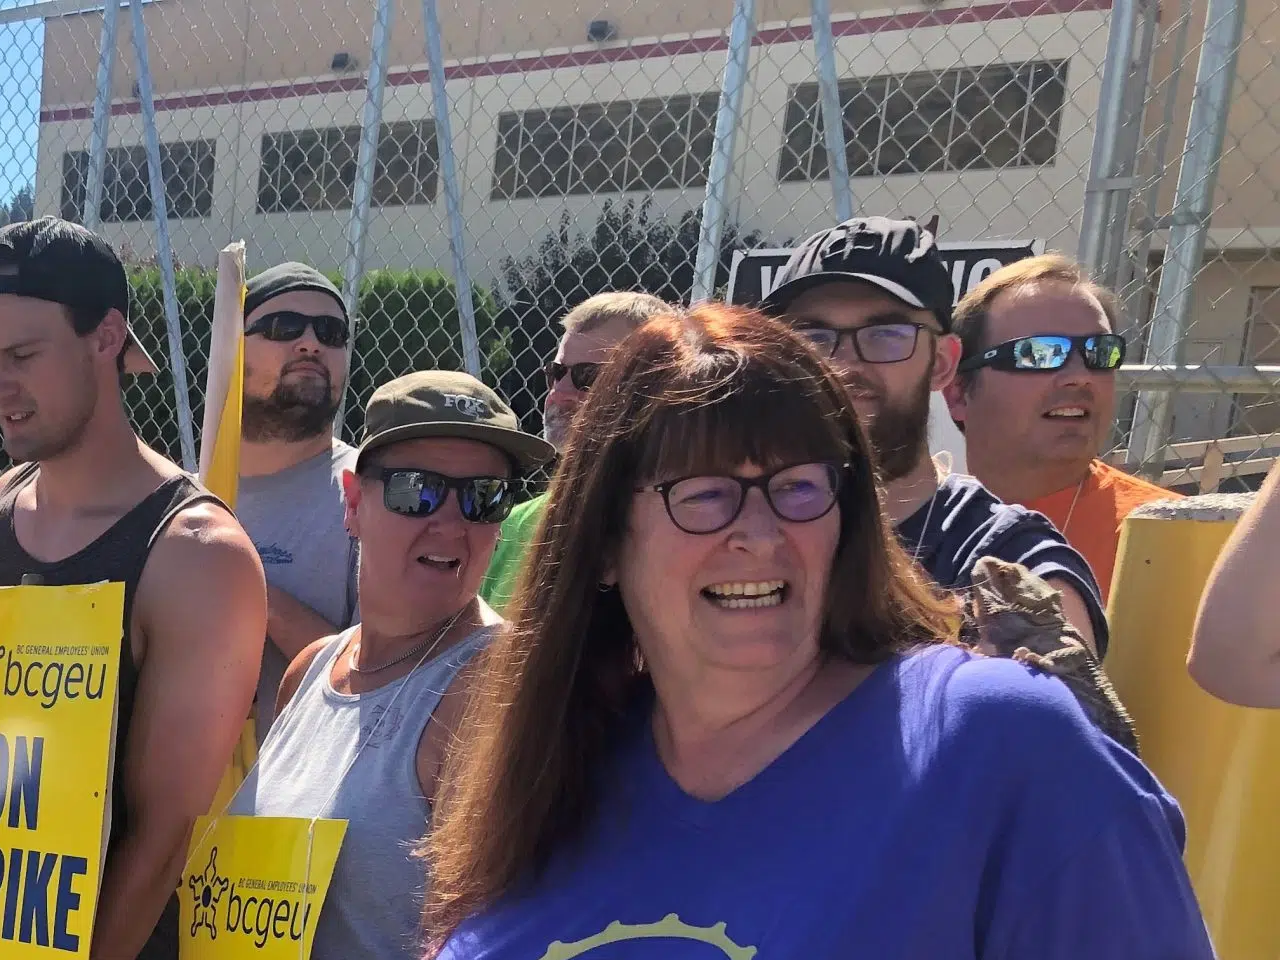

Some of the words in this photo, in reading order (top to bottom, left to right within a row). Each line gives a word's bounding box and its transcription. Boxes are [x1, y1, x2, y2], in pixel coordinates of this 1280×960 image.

[25, 645, 53, 655] GENERAL
[90, 646, 110, 656] UNION
[3, 650, 107, 709] bcgeu
[246, 878, 266, 890] GENERAL
[227, 883, 311, 948] bcgeu
